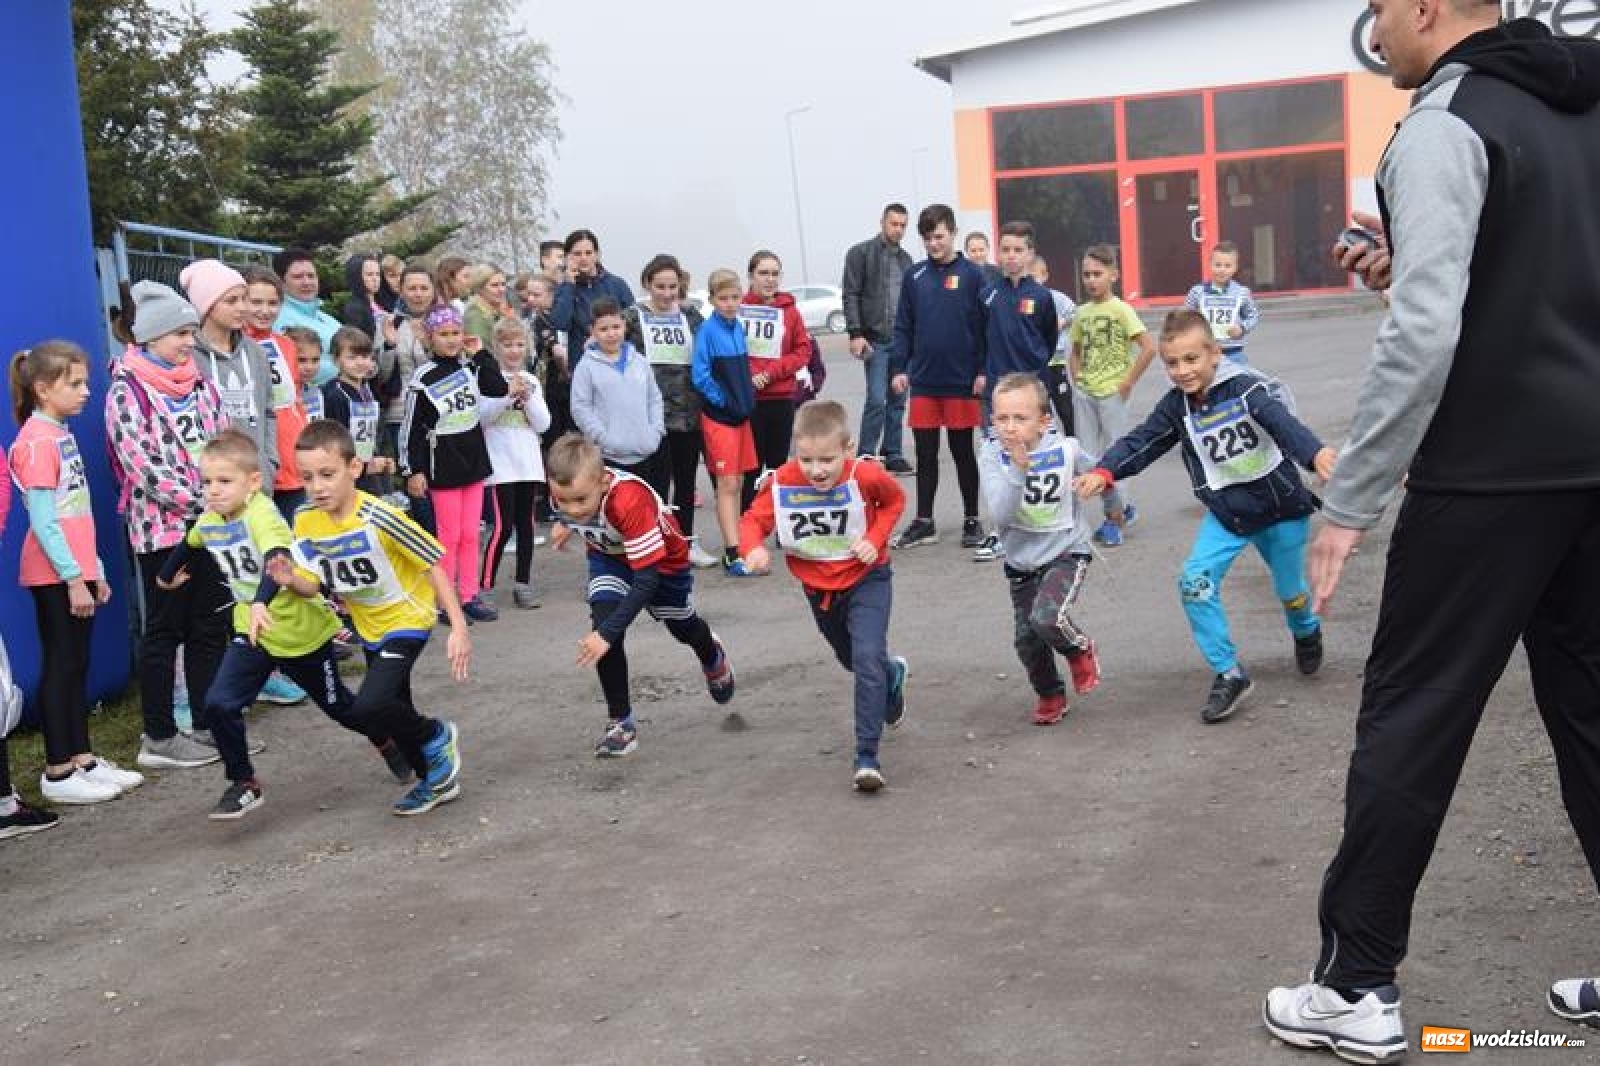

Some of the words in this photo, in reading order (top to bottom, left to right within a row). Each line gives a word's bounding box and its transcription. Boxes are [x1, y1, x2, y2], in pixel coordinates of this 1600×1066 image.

[1202, 420, 1259, 464] 229
[789, 509, 848, 540] 257
[319, 557, 379, 590] 149
